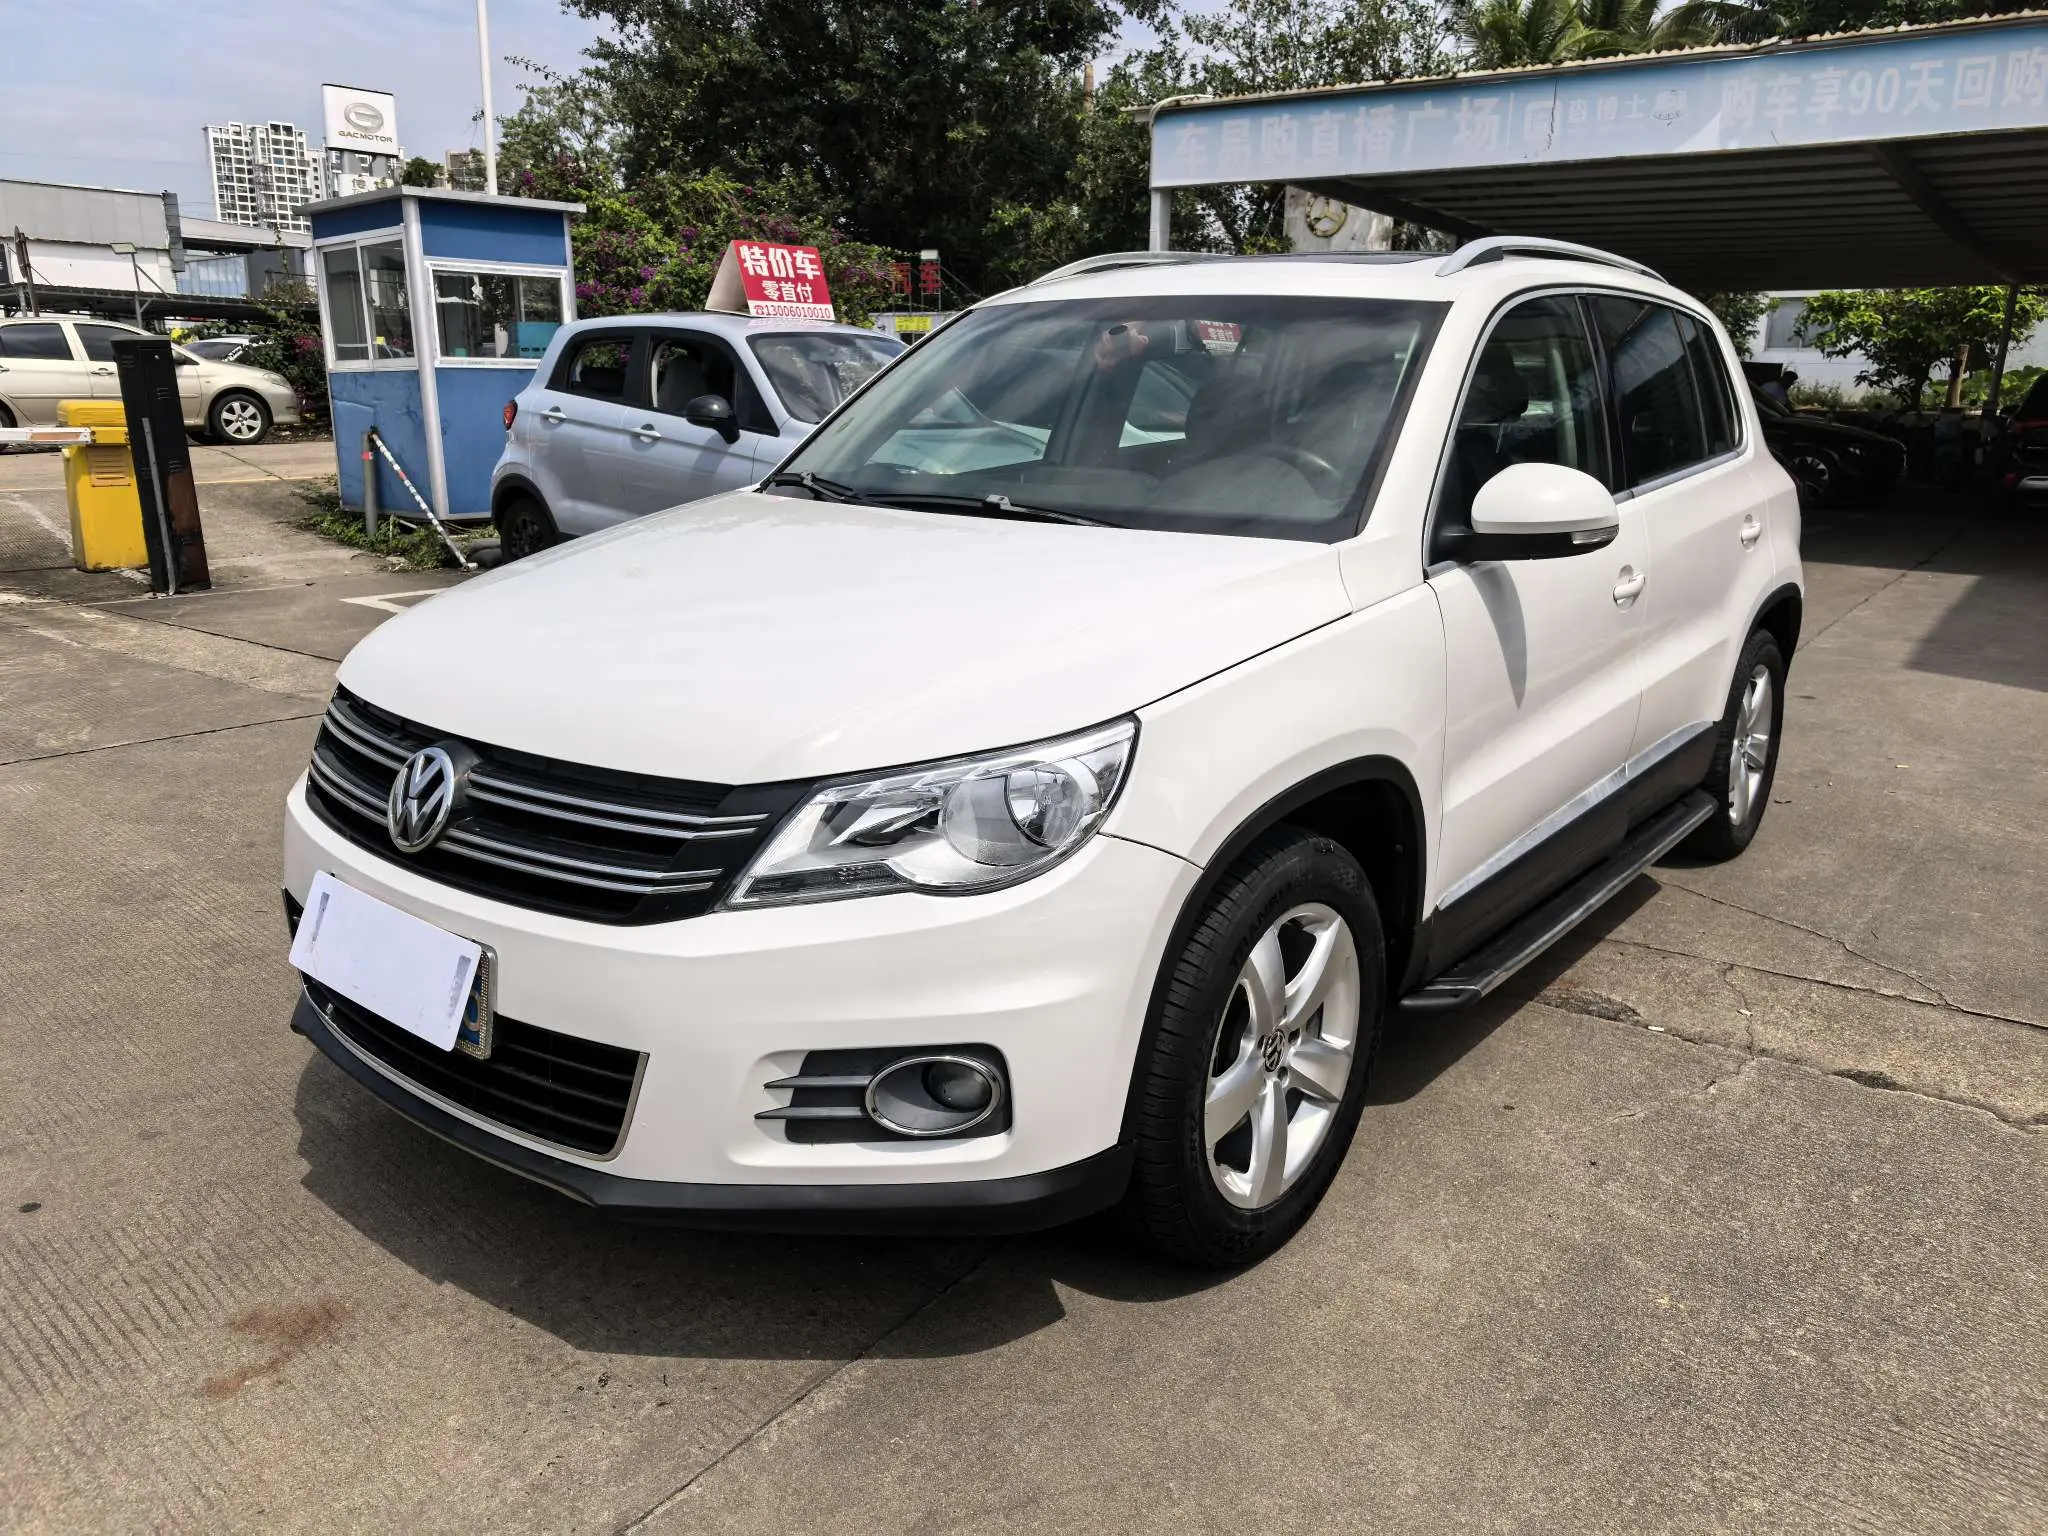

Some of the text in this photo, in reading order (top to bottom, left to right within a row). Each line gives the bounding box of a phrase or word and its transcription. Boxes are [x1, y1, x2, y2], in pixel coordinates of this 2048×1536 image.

[1719, 45, 2048, 130] 购车享90天回购
[739, 245, 821, 280] 特价车
[761, 280, 813, 303] 零首付
[766, 304, 831, 319] 13006010010
